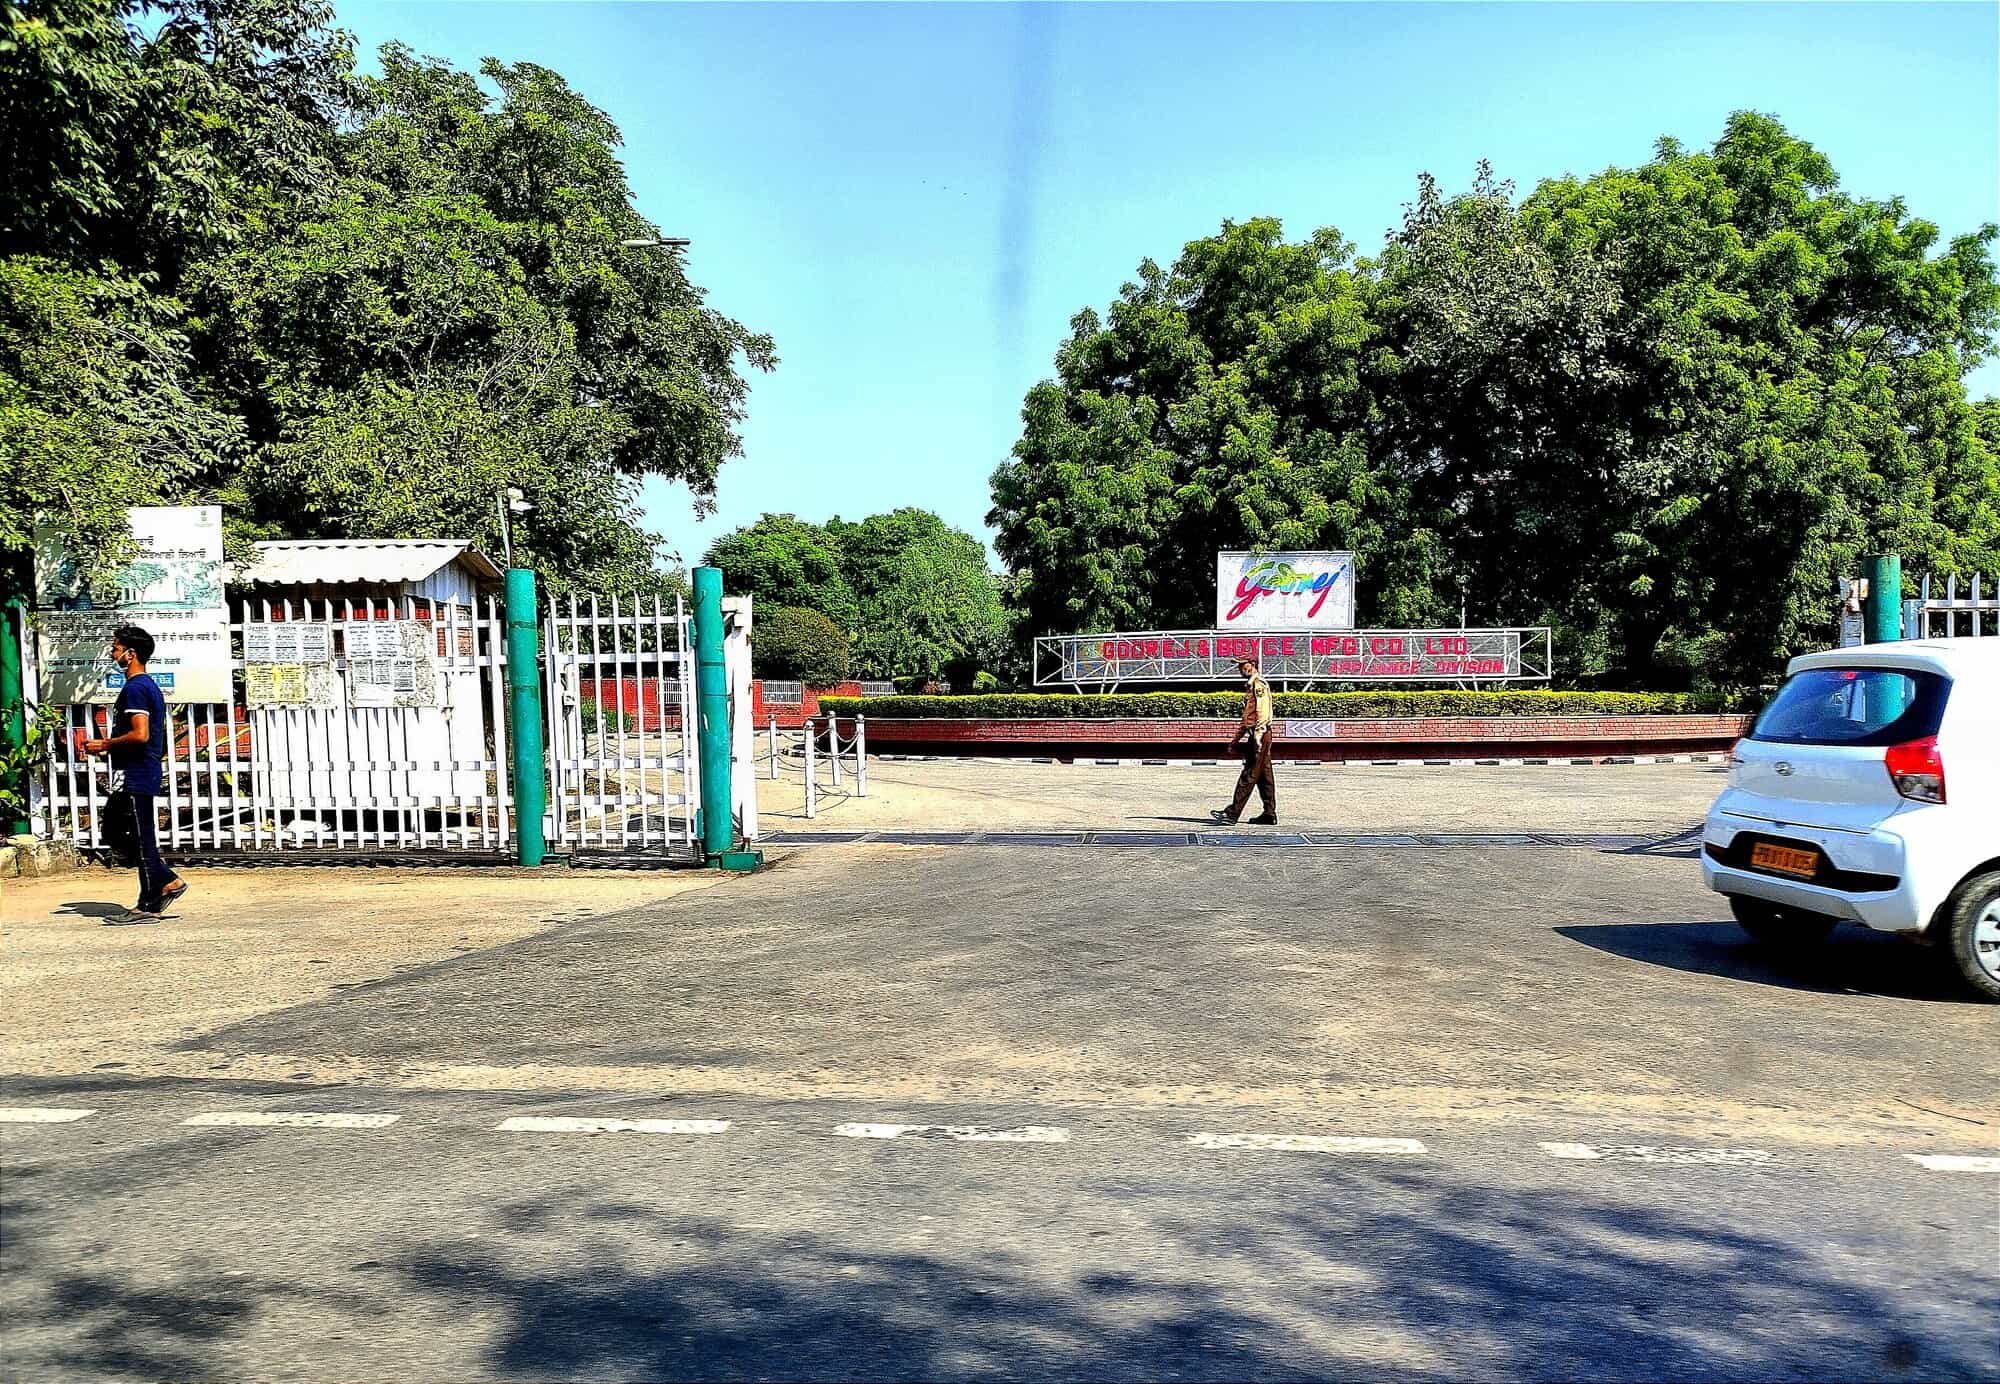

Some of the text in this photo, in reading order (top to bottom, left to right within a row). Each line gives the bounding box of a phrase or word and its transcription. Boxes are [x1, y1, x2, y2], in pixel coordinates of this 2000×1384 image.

[1102, 639, 1190, 660] GODREJ
[1197, 640, 1210, 657] &
[1215, 637, 1296, 658] BOYCE
[1425, 637, 1469, 656] LTD
